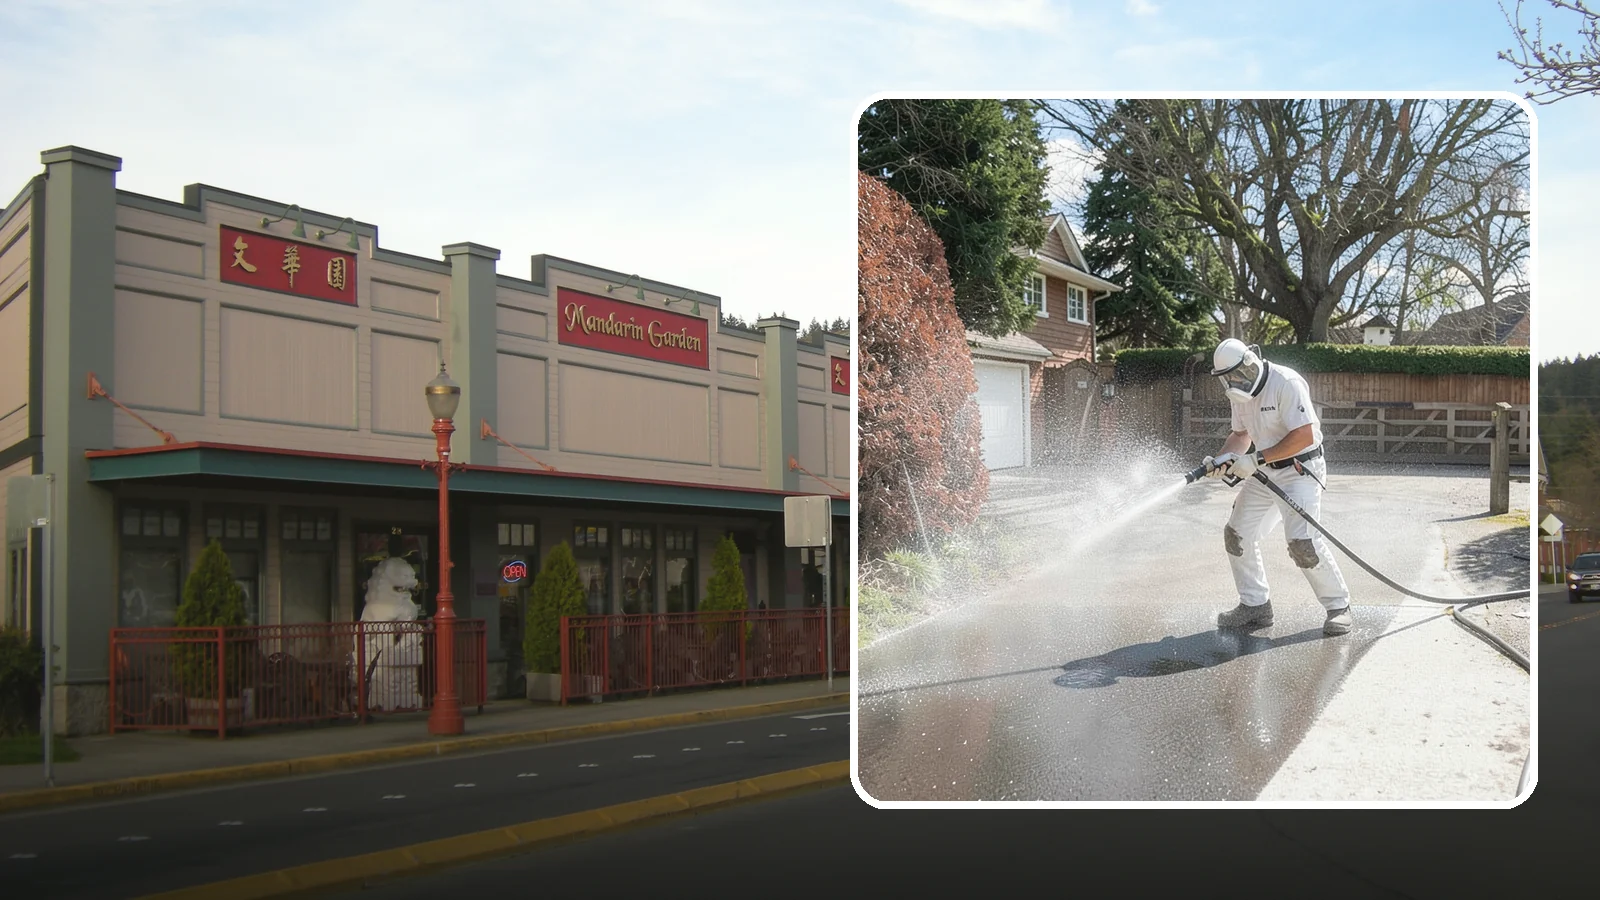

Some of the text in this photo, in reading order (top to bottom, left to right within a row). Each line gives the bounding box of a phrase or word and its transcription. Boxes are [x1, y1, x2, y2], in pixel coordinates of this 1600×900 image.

[231, 236, 346, 291] 文華園
[564, 302, 702, 352] Mandarin Garden
[835, 363, 847, 386] 文
[503, 565, 526, 578] OPEN
